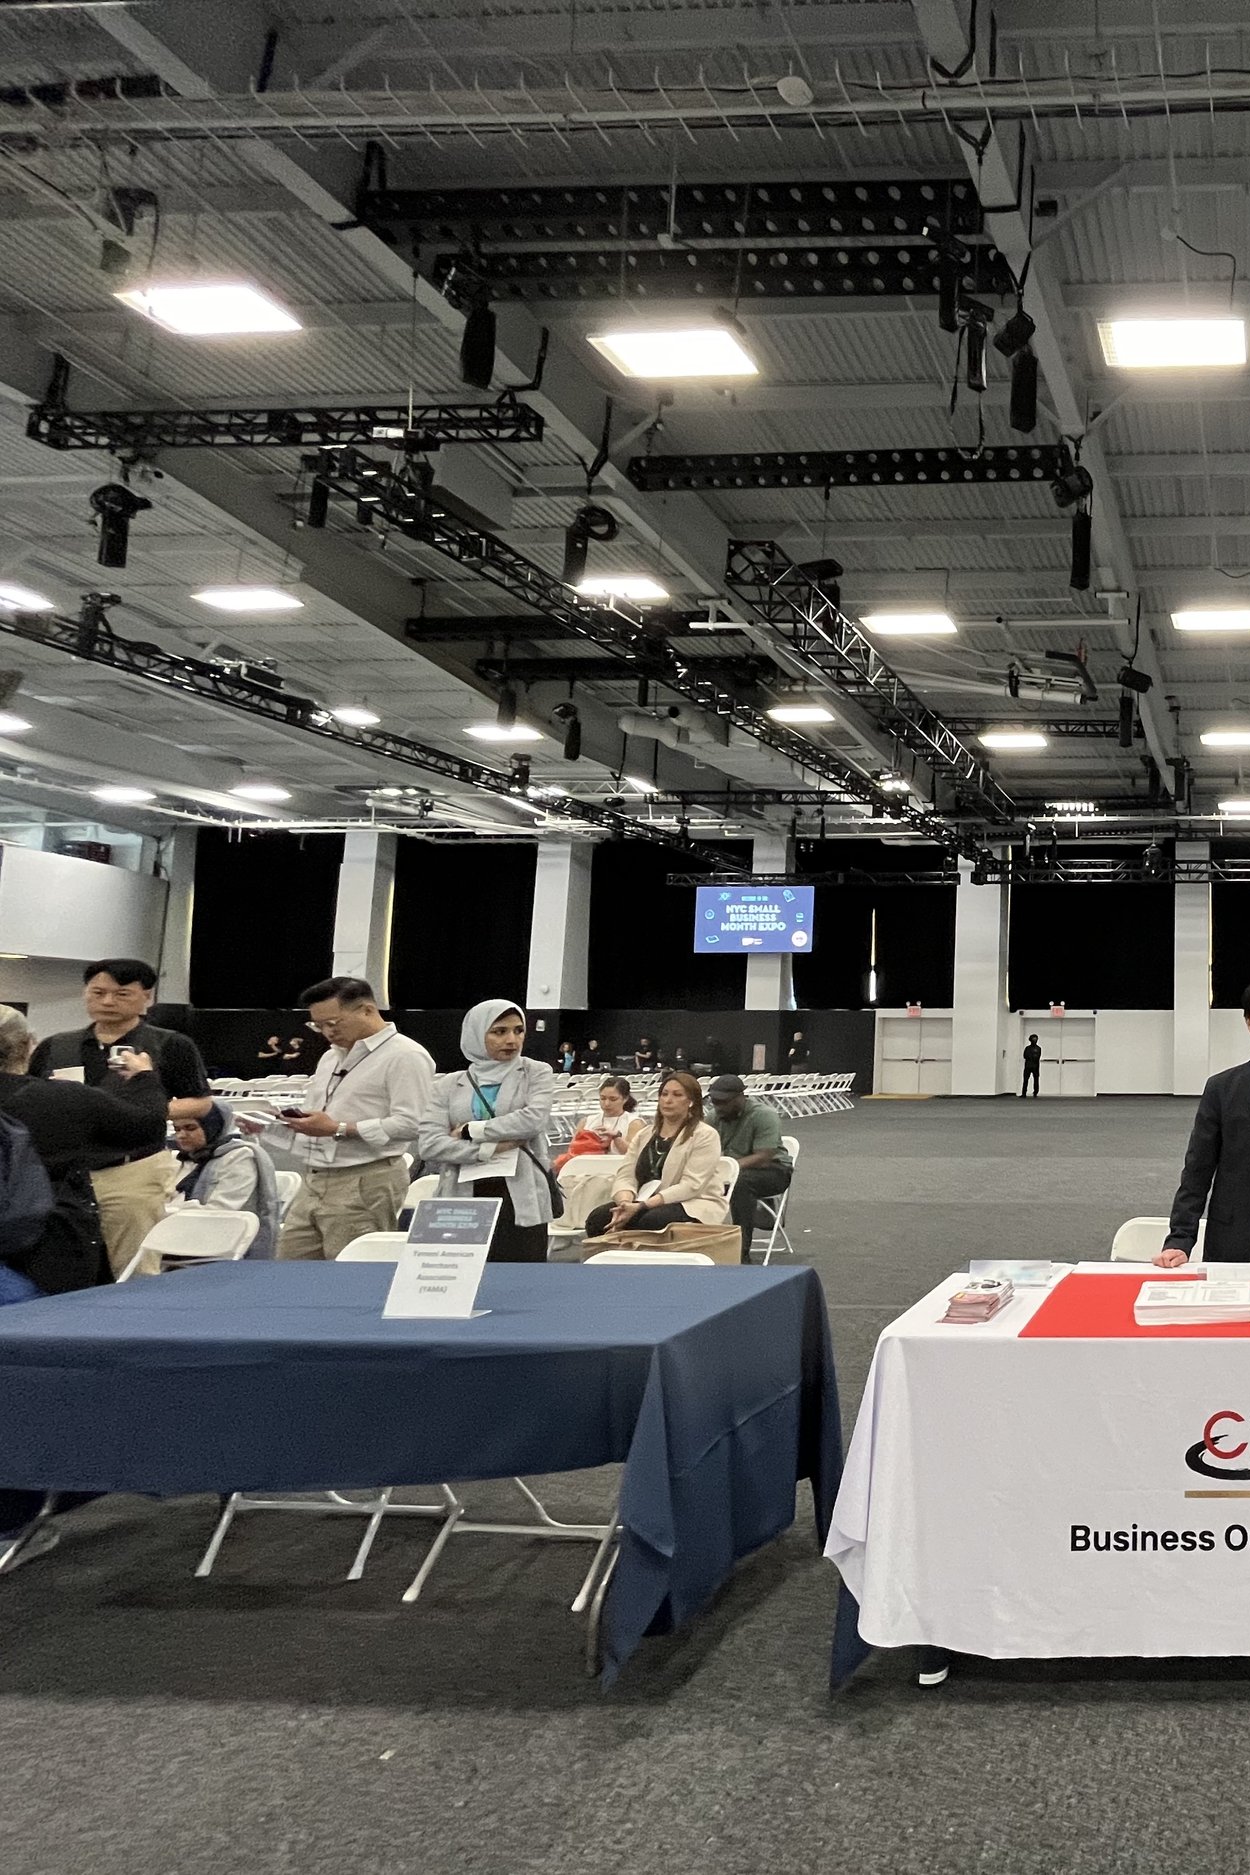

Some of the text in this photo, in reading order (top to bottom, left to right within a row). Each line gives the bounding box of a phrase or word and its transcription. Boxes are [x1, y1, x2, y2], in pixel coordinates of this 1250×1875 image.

[726, 904, 781, 914] NYC SMALL
[730, 914, 777, 922] BUSINESS
[721, 922, 786, 931] MONTH EXPO
[1070, 1523, 1215, 1552] Business
